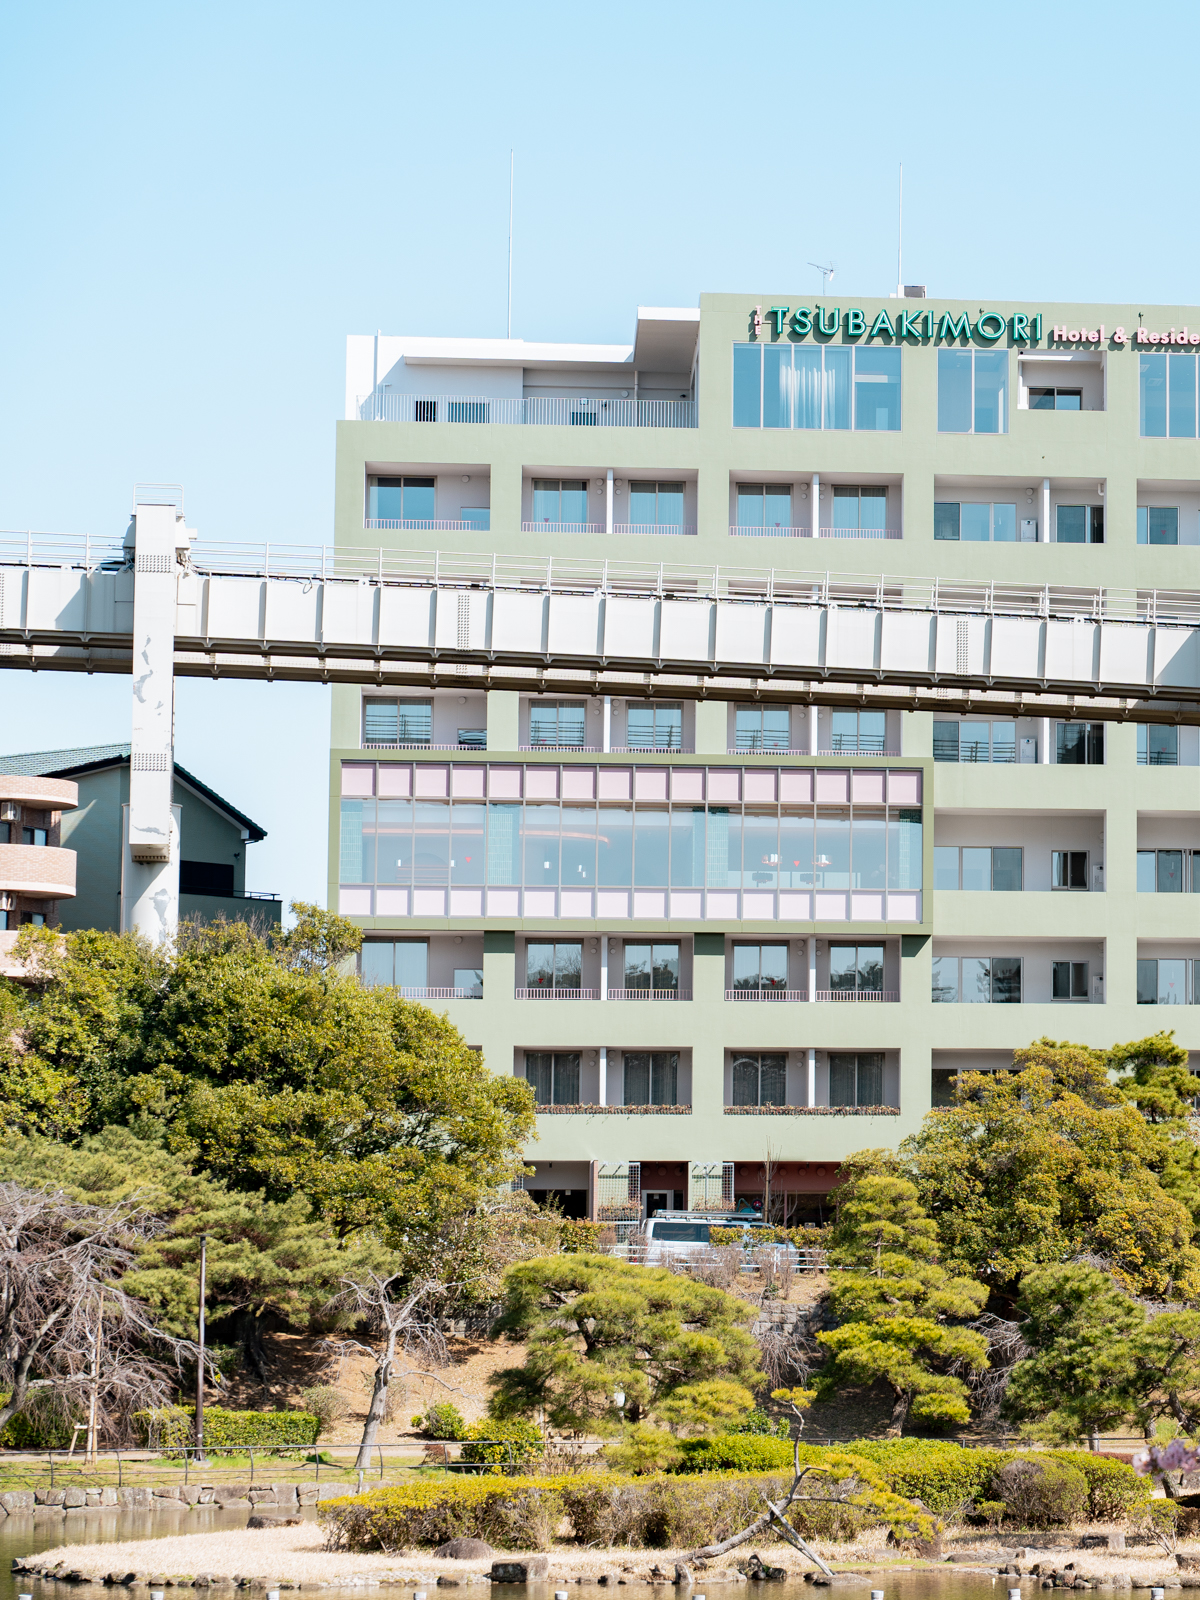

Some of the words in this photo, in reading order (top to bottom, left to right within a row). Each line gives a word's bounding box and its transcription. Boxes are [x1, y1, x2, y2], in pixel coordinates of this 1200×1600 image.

[754, 305, 763, 335] THE
[771, 306, 1043, 341] TSUBAKIMORI
[1053, 325, 1104, 343] Hotel
[1113, 326, 1128, 343] &
